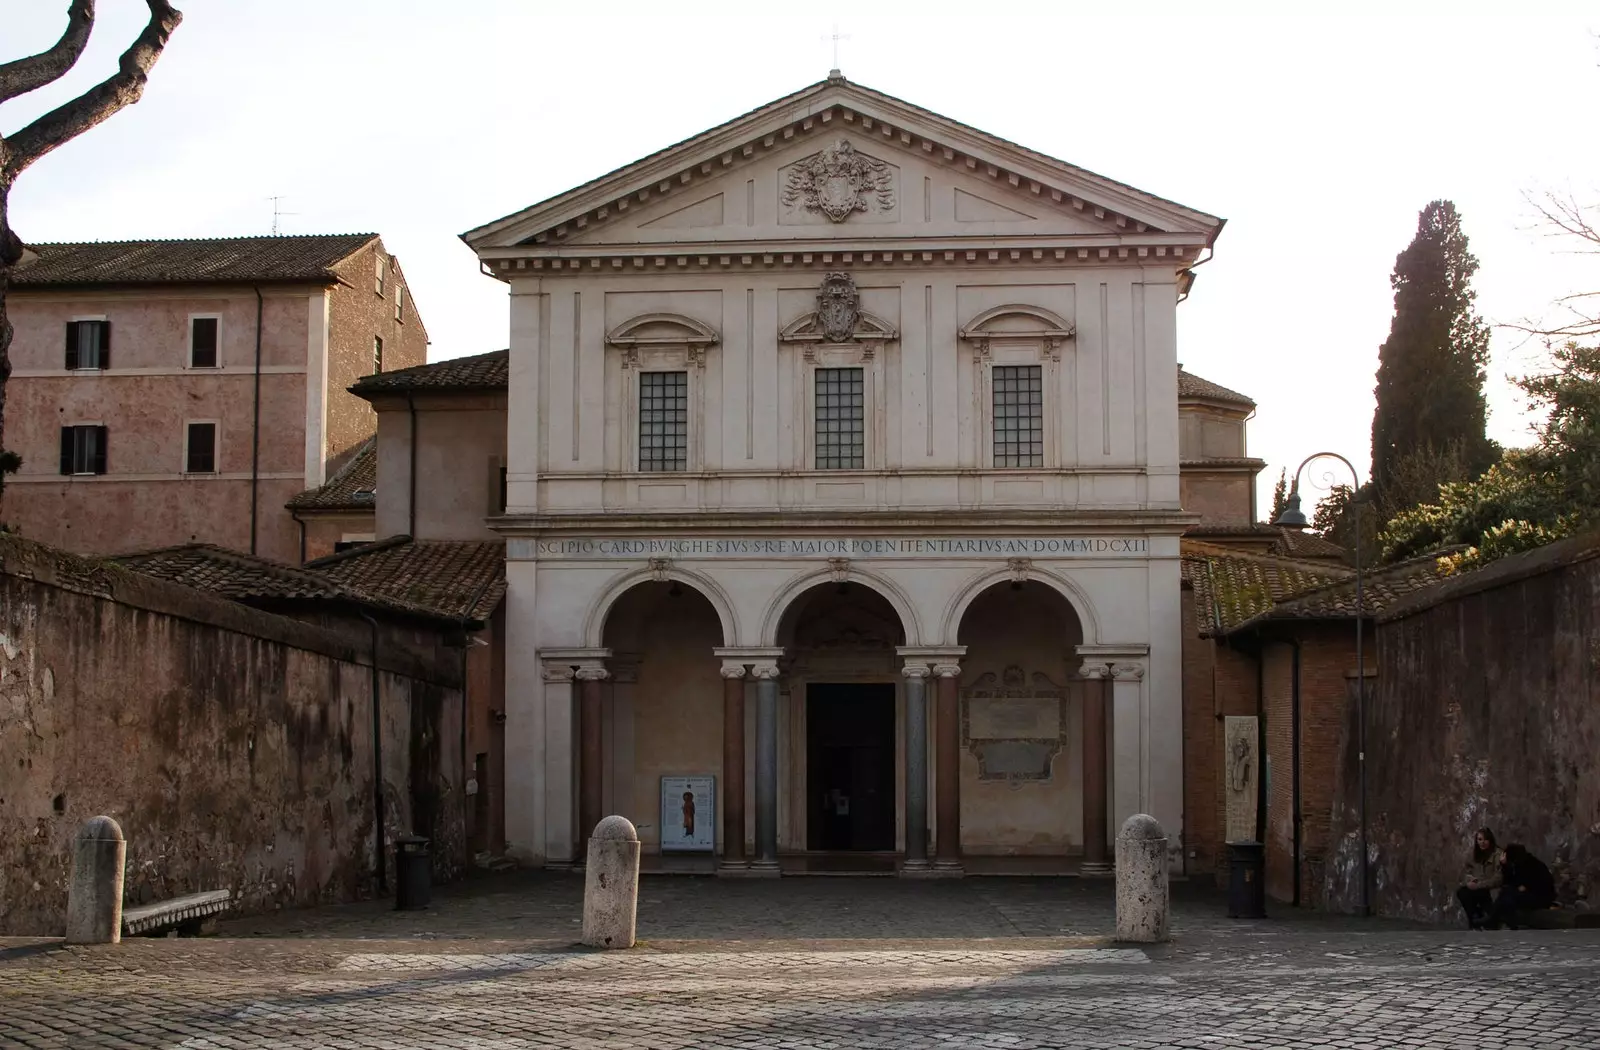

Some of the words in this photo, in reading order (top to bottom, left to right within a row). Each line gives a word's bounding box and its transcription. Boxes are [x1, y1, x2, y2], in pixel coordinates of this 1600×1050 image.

[539, 541, 594, 554] SCIPIO
[599, 541, 645, 553] CARD
[650, 540, 749, 553] BVRGHESIVS
[791, 540, 849, 553] MAIOR
[852, 540, 1002, 553] POENITENTIARIVS
[1005, 540, 1028, 553] AN
[1033, 540, 1075, 553] DOM
[1080, 539, 1147, 552] MDCXII
